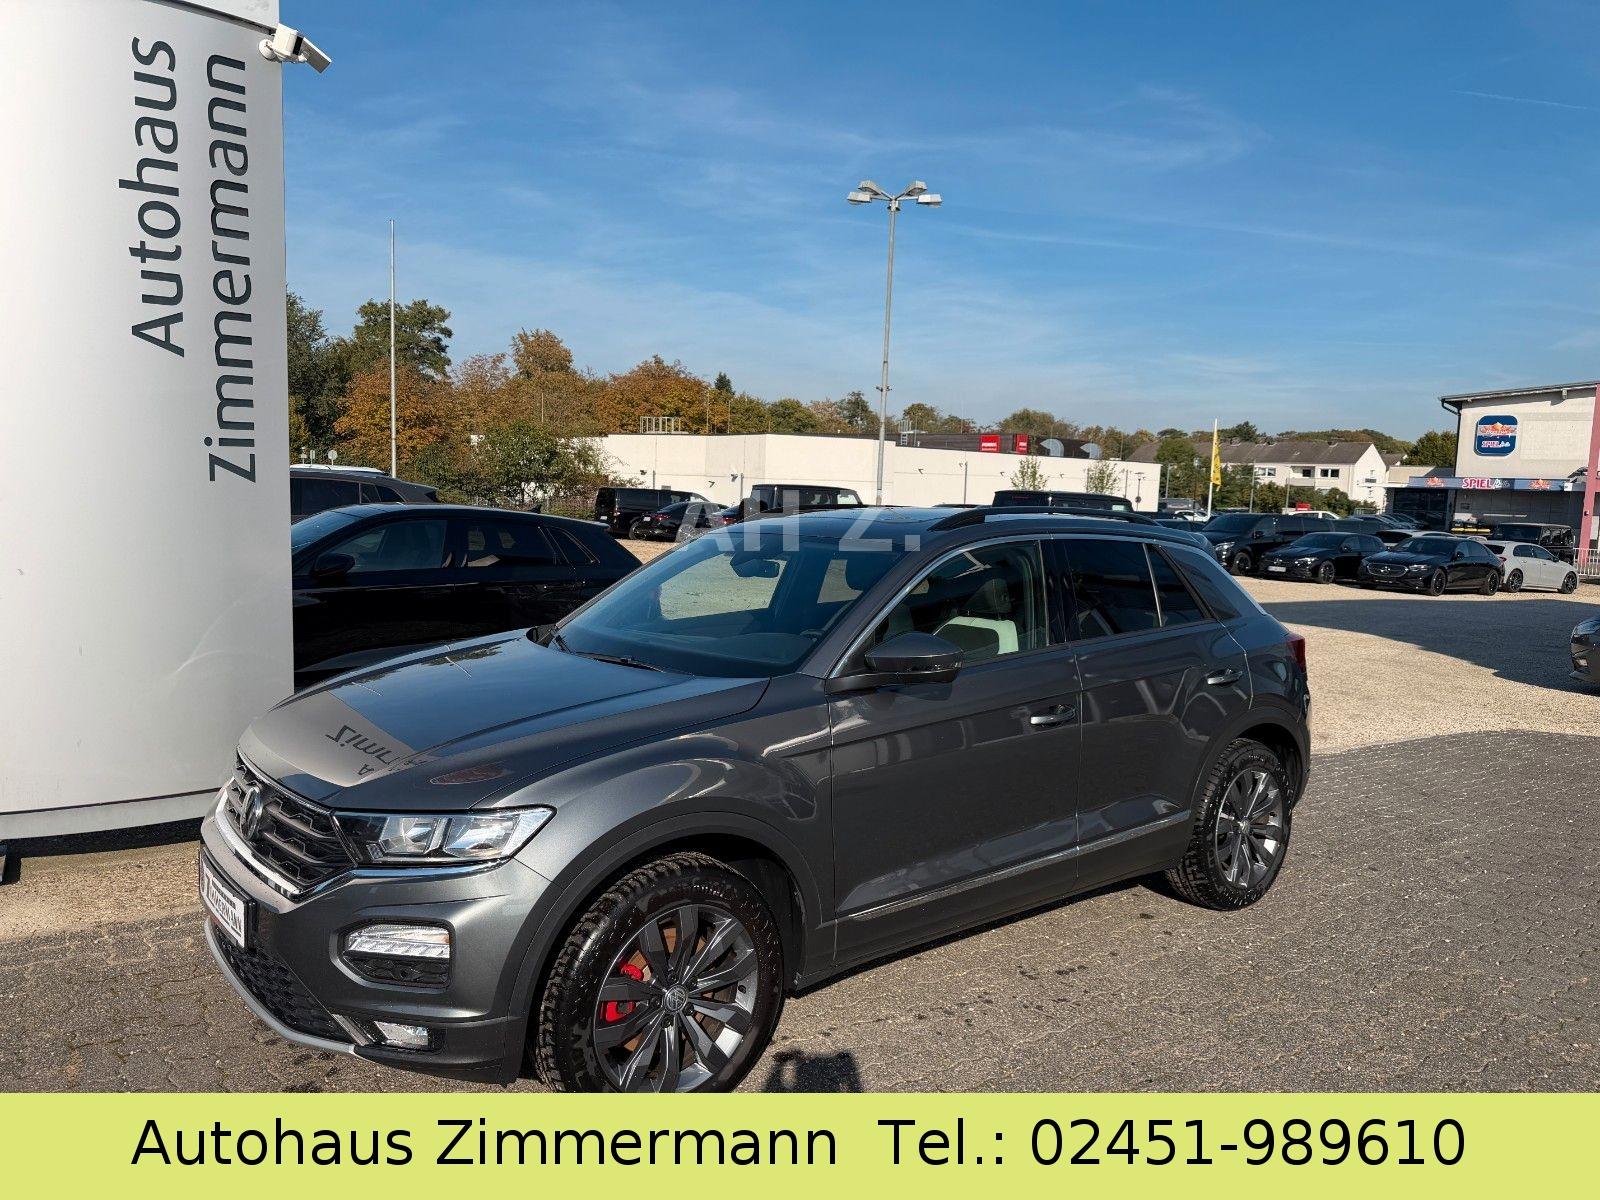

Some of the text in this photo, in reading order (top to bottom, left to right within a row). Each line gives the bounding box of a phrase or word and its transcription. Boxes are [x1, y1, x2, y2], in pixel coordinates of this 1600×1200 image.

[118, 36, 185, 357] Autohaus
[203, 53, 256, 484] Zimmermann
[1461, 478, 1493, 489] SPIEL
